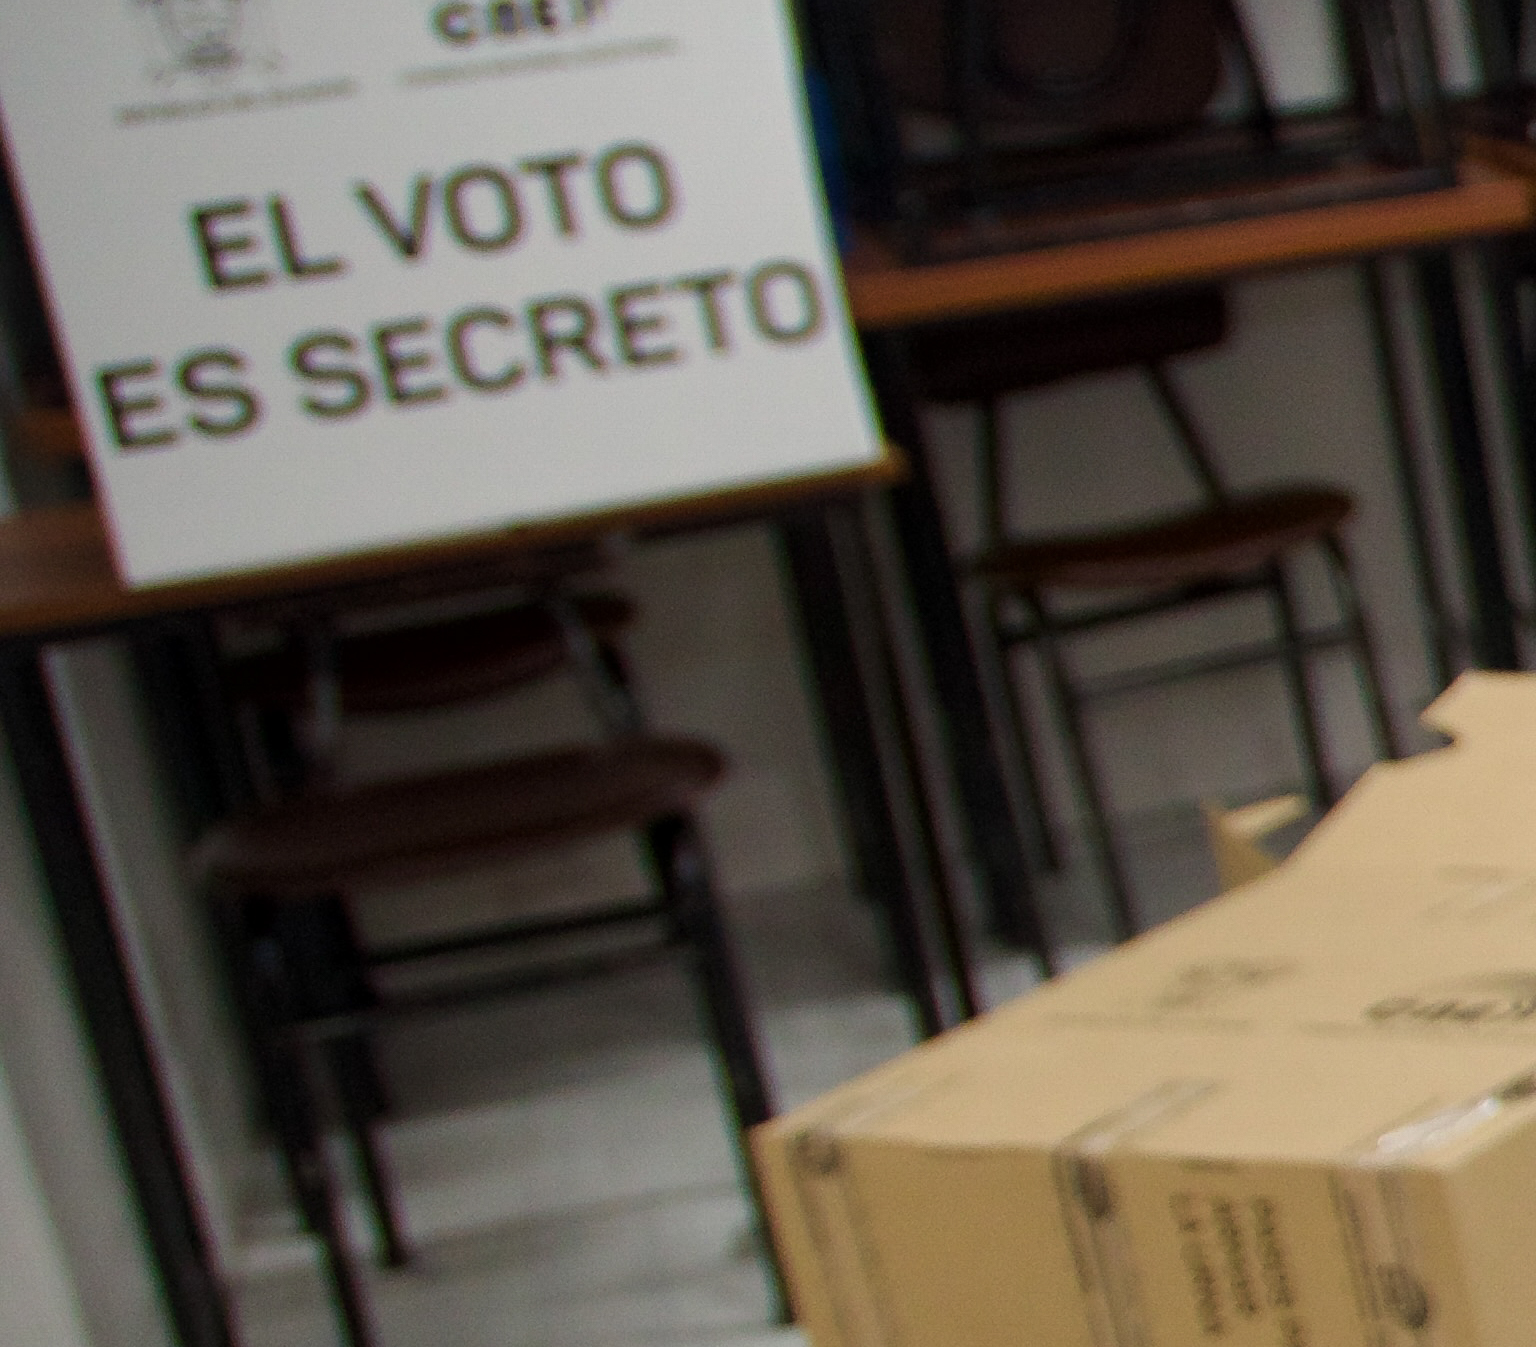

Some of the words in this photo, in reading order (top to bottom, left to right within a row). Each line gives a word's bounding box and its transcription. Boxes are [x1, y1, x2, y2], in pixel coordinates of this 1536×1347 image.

[189, 195, 344, 294] EL
[354, 142, 678, 262] VOTO
[96, 347, 262, 454] ES
[289, 257, 826, 422] SECRETO
